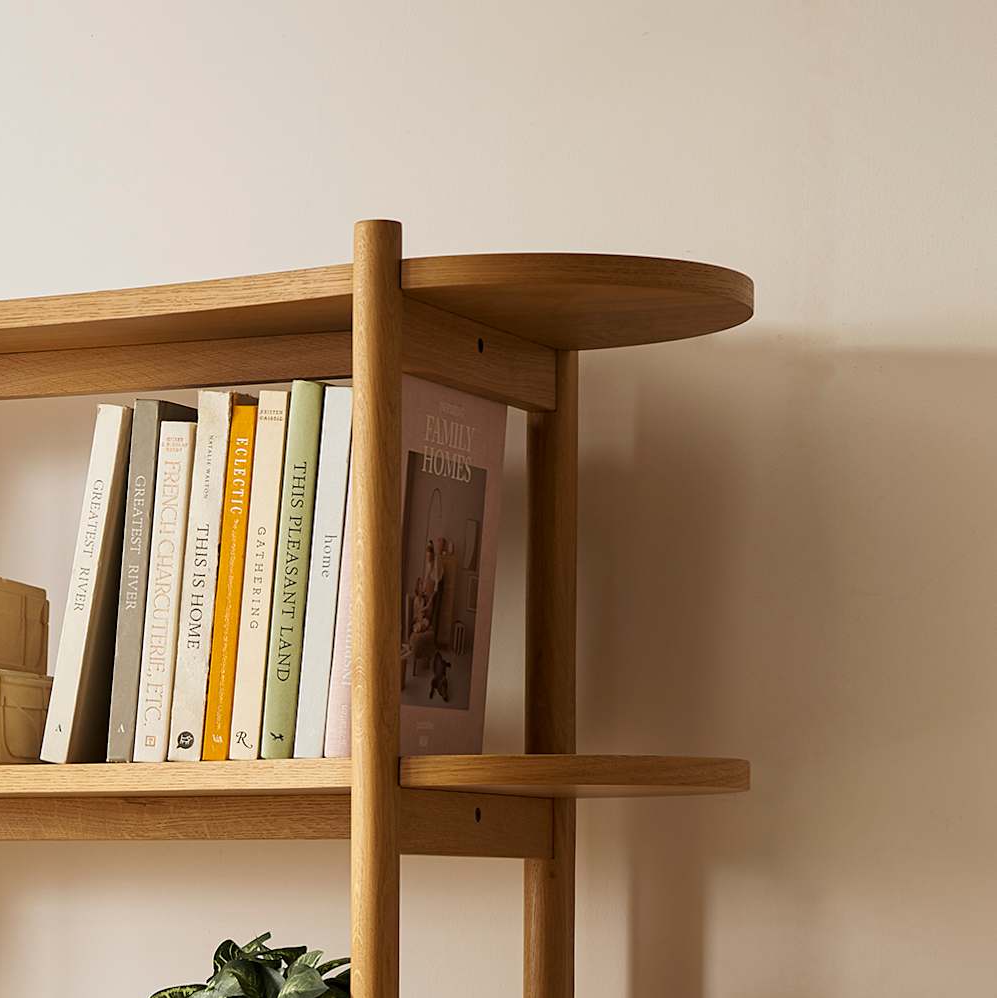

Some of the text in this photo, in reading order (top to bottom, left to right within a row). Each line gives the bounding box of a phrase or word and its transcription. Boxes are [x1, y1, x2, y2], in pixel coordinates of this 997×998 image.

[230, 437, 249, 515] ECLECTIC
[421, 445, 473, 483] HOMES
[425, 414, 475, 452] FAMILY
[125, 475, 147, 610] GREATEST RIVER
[158, 460, 183, 534] FRENCH
[73, 479, 104, 611] GREATEST RIVER
[187, 523, 209, 649] THIS IS HOME
[249, 526, 267, 630] GATHERING
[276, 461, 307, 682] THIS PLEASANT LAND
[321, 534, 337, 579] home
[148, 540, 175, 678] CHARCUTERIE,
[143, 681, 164, 727] ETC.
